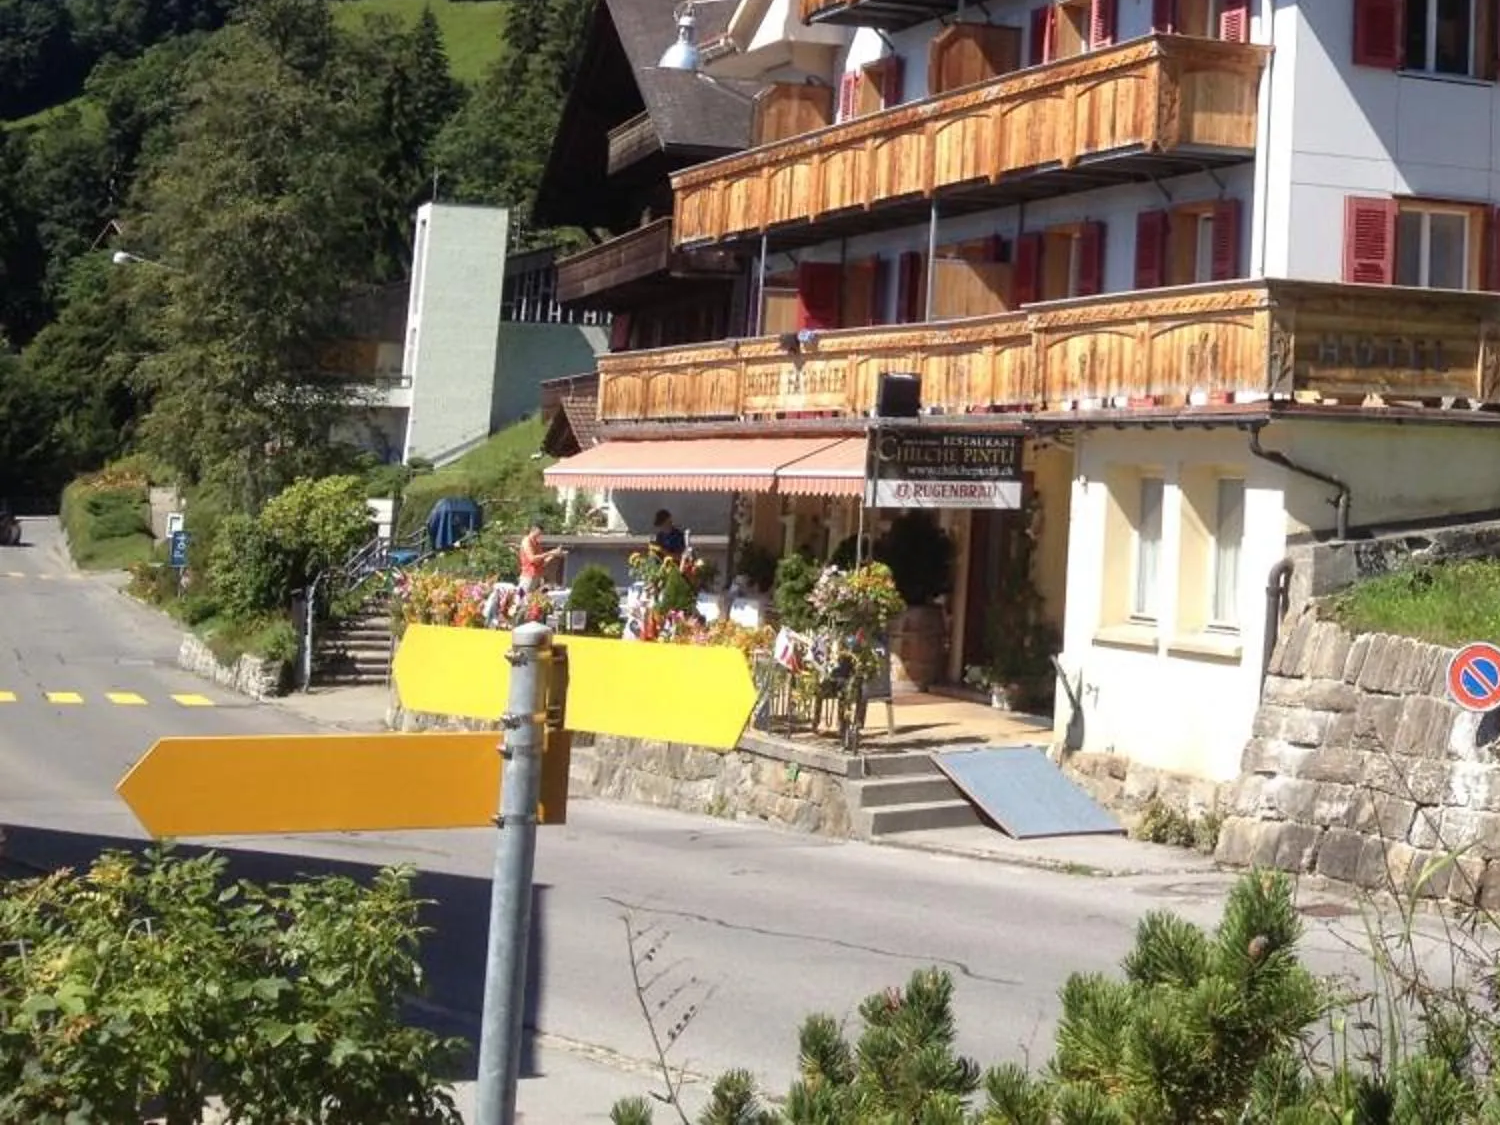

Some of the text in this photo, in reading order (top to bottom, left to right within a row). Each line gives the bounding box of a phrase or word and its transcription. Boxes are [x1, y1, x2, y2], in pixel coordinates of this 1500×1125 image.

[1319, 335, 1447, 370] HOTEL
[943, 436, 1015, 447] RESTAURANT
[963, 447, 1015, 463] PINTLI
